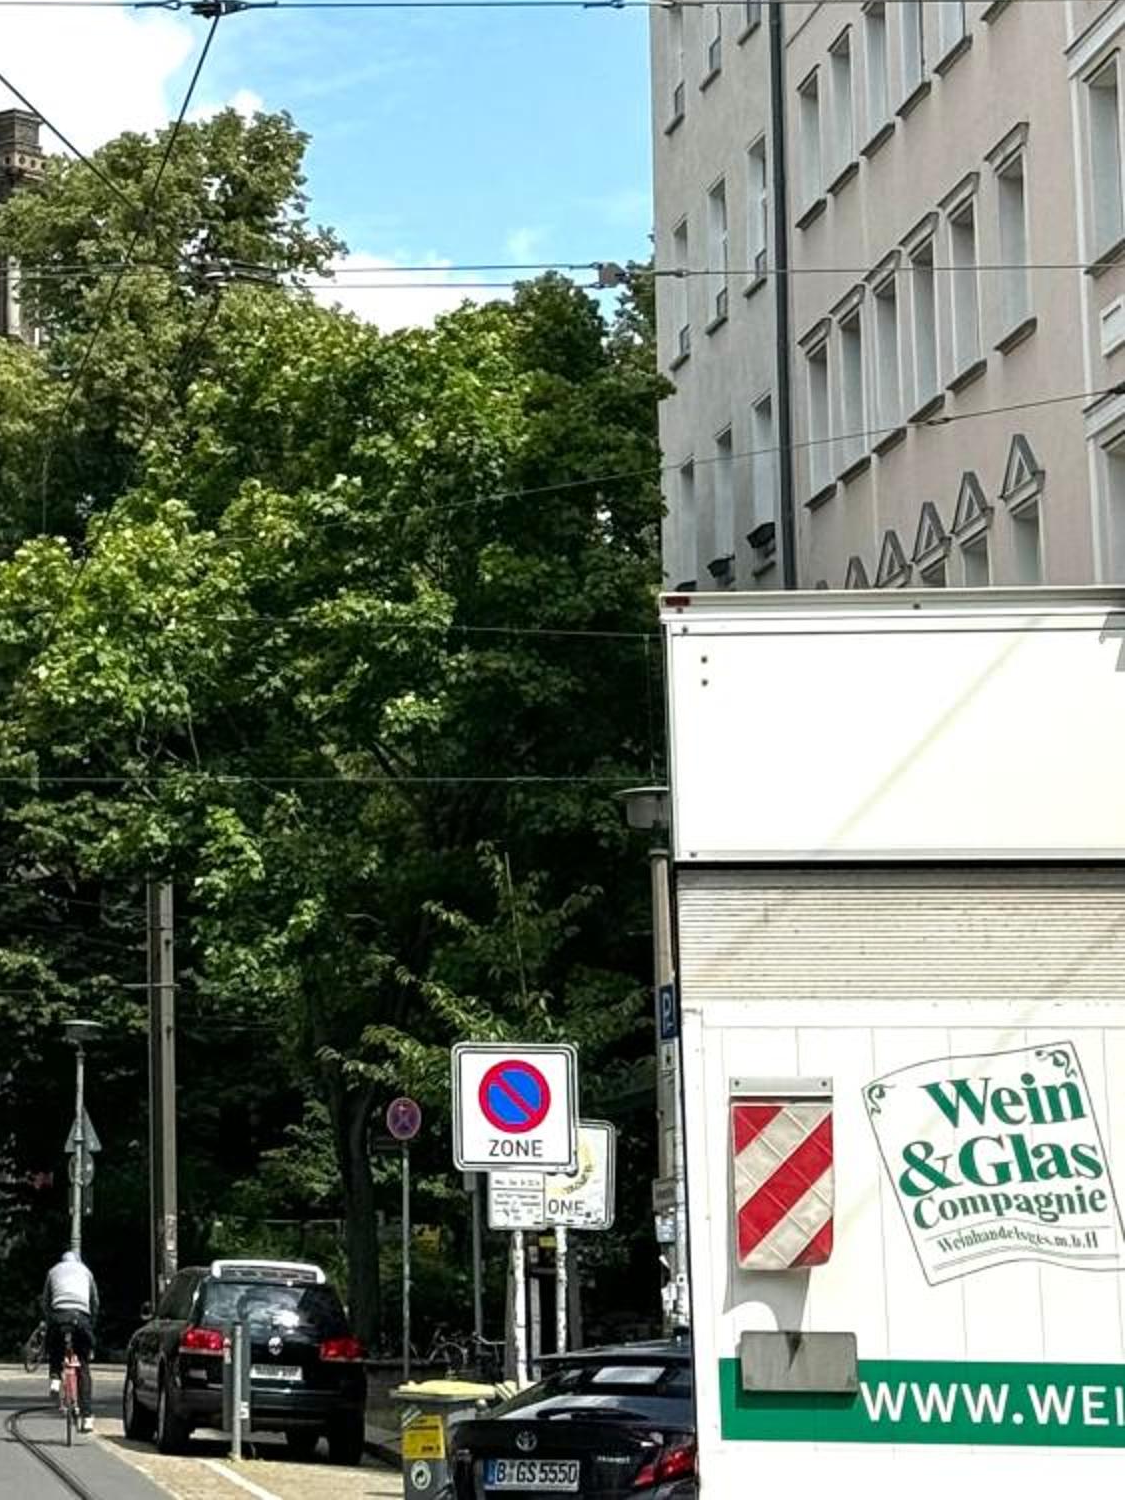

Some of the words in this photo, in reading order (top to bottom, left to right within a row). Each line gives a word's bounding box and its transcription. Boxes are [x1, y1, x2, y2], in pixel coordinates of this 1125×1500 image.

[919, 1073, 1087, 1129] Wein
[489, 1140, 543, 1157] ZONE
[548, 1199, 585, 1215] ONE
[913, 1185, 1107, 1229] Compagnie
[496, 1461, 507, 1483] B
